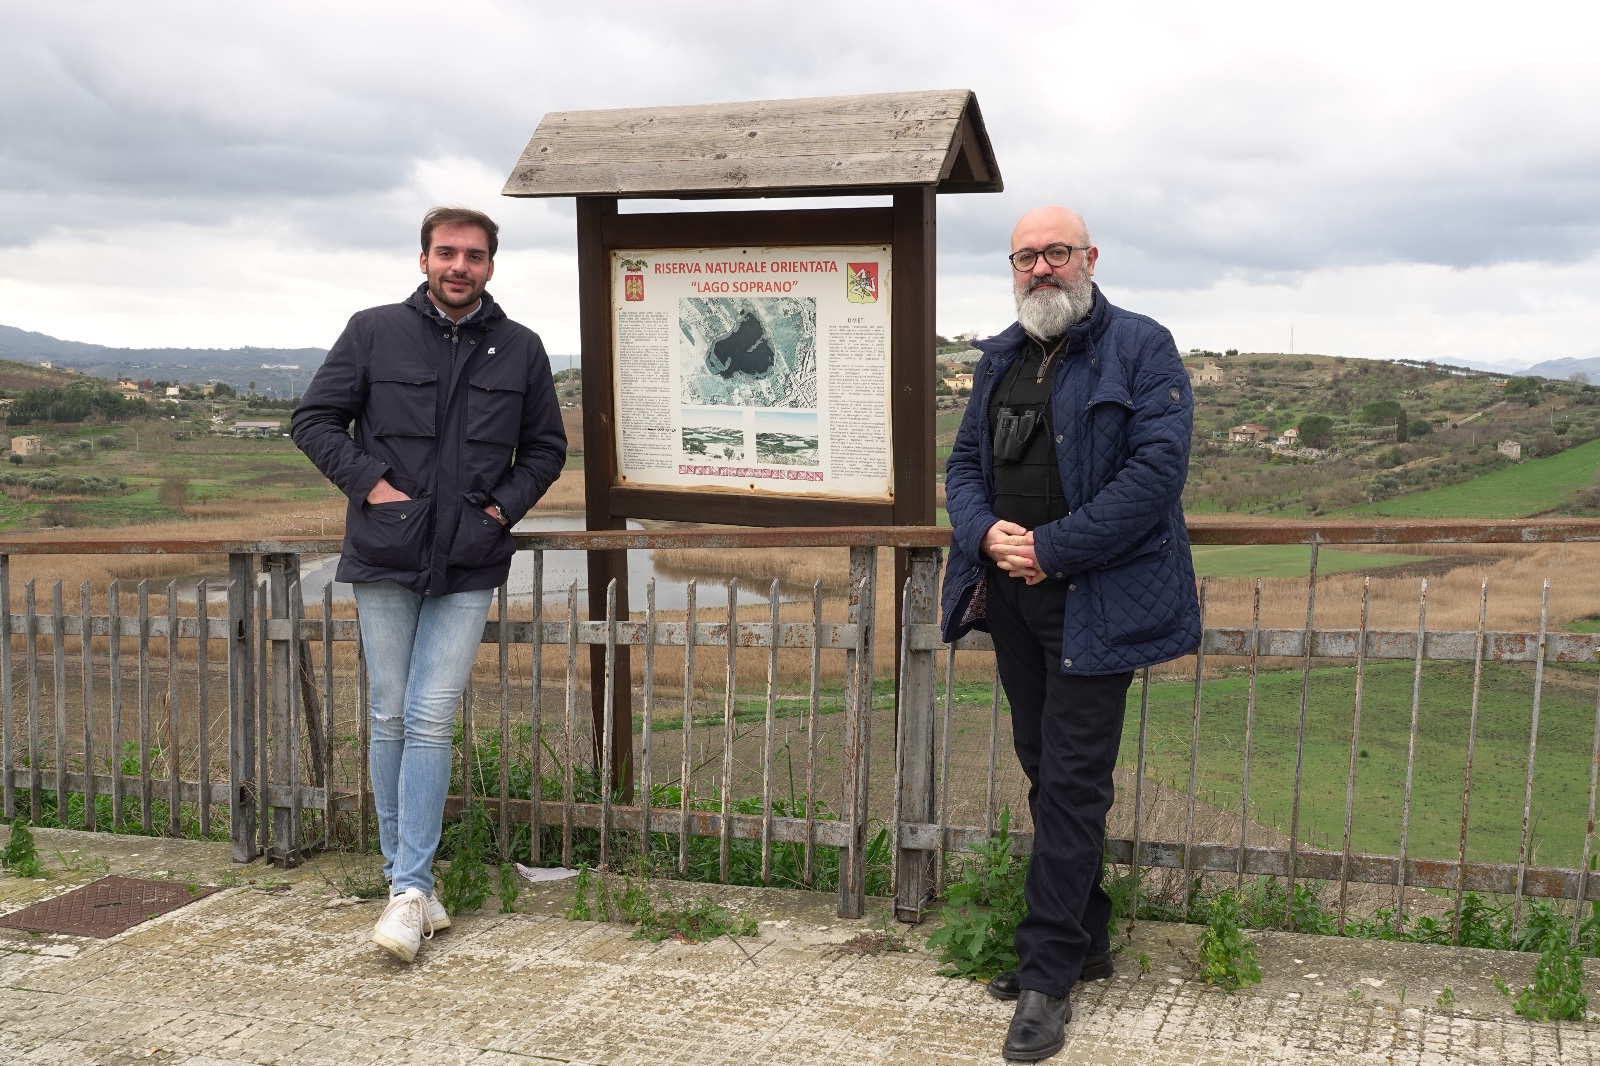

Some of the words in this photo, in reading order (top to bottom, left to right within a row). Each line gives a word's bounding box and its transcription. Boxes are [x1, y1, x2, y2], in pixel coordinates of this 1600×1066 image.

[654, 262, 701, 274] RISERVA
[705, 261, 767, 274] NATURALE
[770, 260, 838, 273] ORIENTATA
